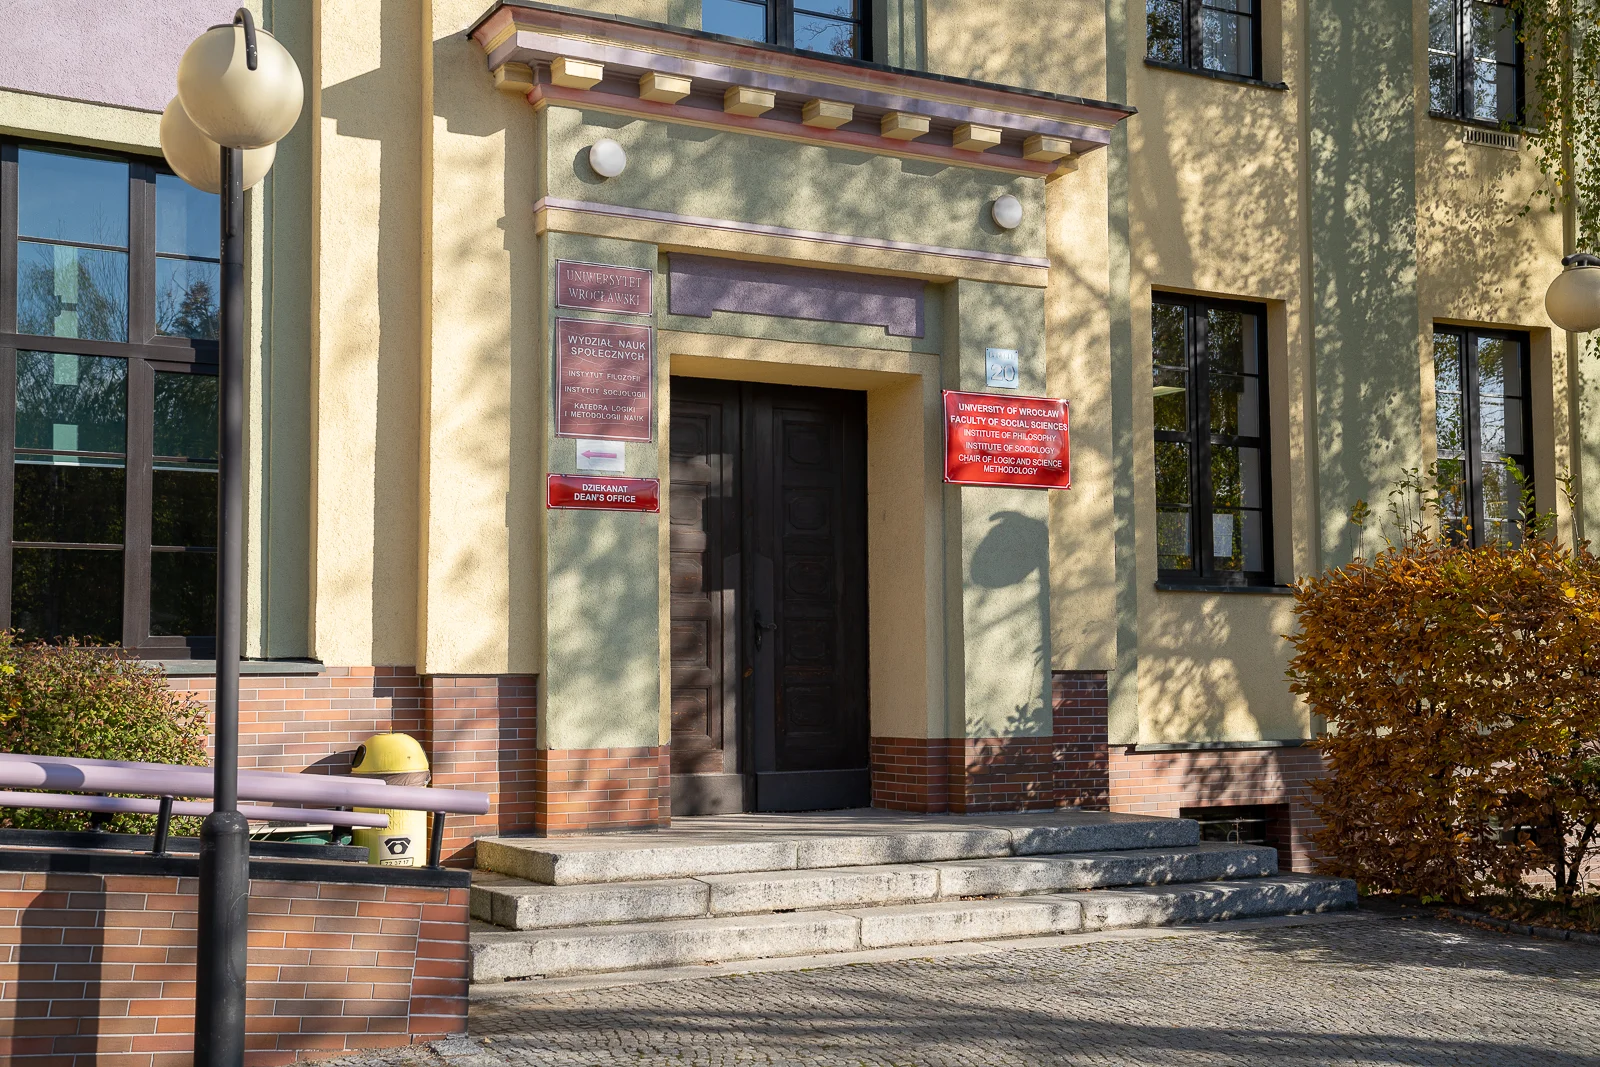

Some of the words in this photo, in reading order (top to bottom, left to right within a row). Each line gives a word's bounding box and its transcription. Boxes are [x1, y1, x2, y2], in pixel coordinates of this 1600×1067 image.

[566, 270, 642, 288] UNIWERSYTET
[568, 288, 640, 306] WROCŁAWSKI
[568, 336, 614, 348] WYDZIAŁ
[618, 340, 646, 350] NAUK
[570, 346, 645, 361] SPOŁECZNYCH
[568, 370, 604, 379] INSTYTUT
[606, 373, 640, 382] FILOZOFII
[990, 363, 1016, 382] 20
[564, 386, 600, 394] INSTYTUT
[602, 388, 646, 398] SOCJOLOGII
[574, 402, 608, 412] KATEDRA
[958, 403, 1005, 414] UNIVERSITY
[1006, 406, 1018, 415] OF
[1018, 408, 1060, 418] WROCŁAW
[570, 411, 620, 420] METODOLOGII
[950, 415, 986, 425] FACULTY
[988, 418, 999, 426] OF
[1000, 418, 1030, 428] SOCIAL
[1030, 420, 1068, 432] SCIENCES
[963, 428, 1000, 438] INSTITUTE
[1012, 432, 1057, 442] PHILOSOPHY
[966, 442, 1002, 452] INSTITUTE
[1014, 445, 1055, 455] SOCIOLOGY
[958, 454, 981, 462] CHAIR
[982, 456, 992, 464] OF
[994, 456, 1016, 464] LOGIC
[1016, 458, 1031, 466] AND
[1032, 458, 1062, 468] SCIENCE
[984, 464, 1038, 476] METHODOLOGY
[582, 484, 628, 493] DZIEKANAT
[574, 492, 604, 502] DEAN'S
[606, 494, 636, 503] OFFICE
